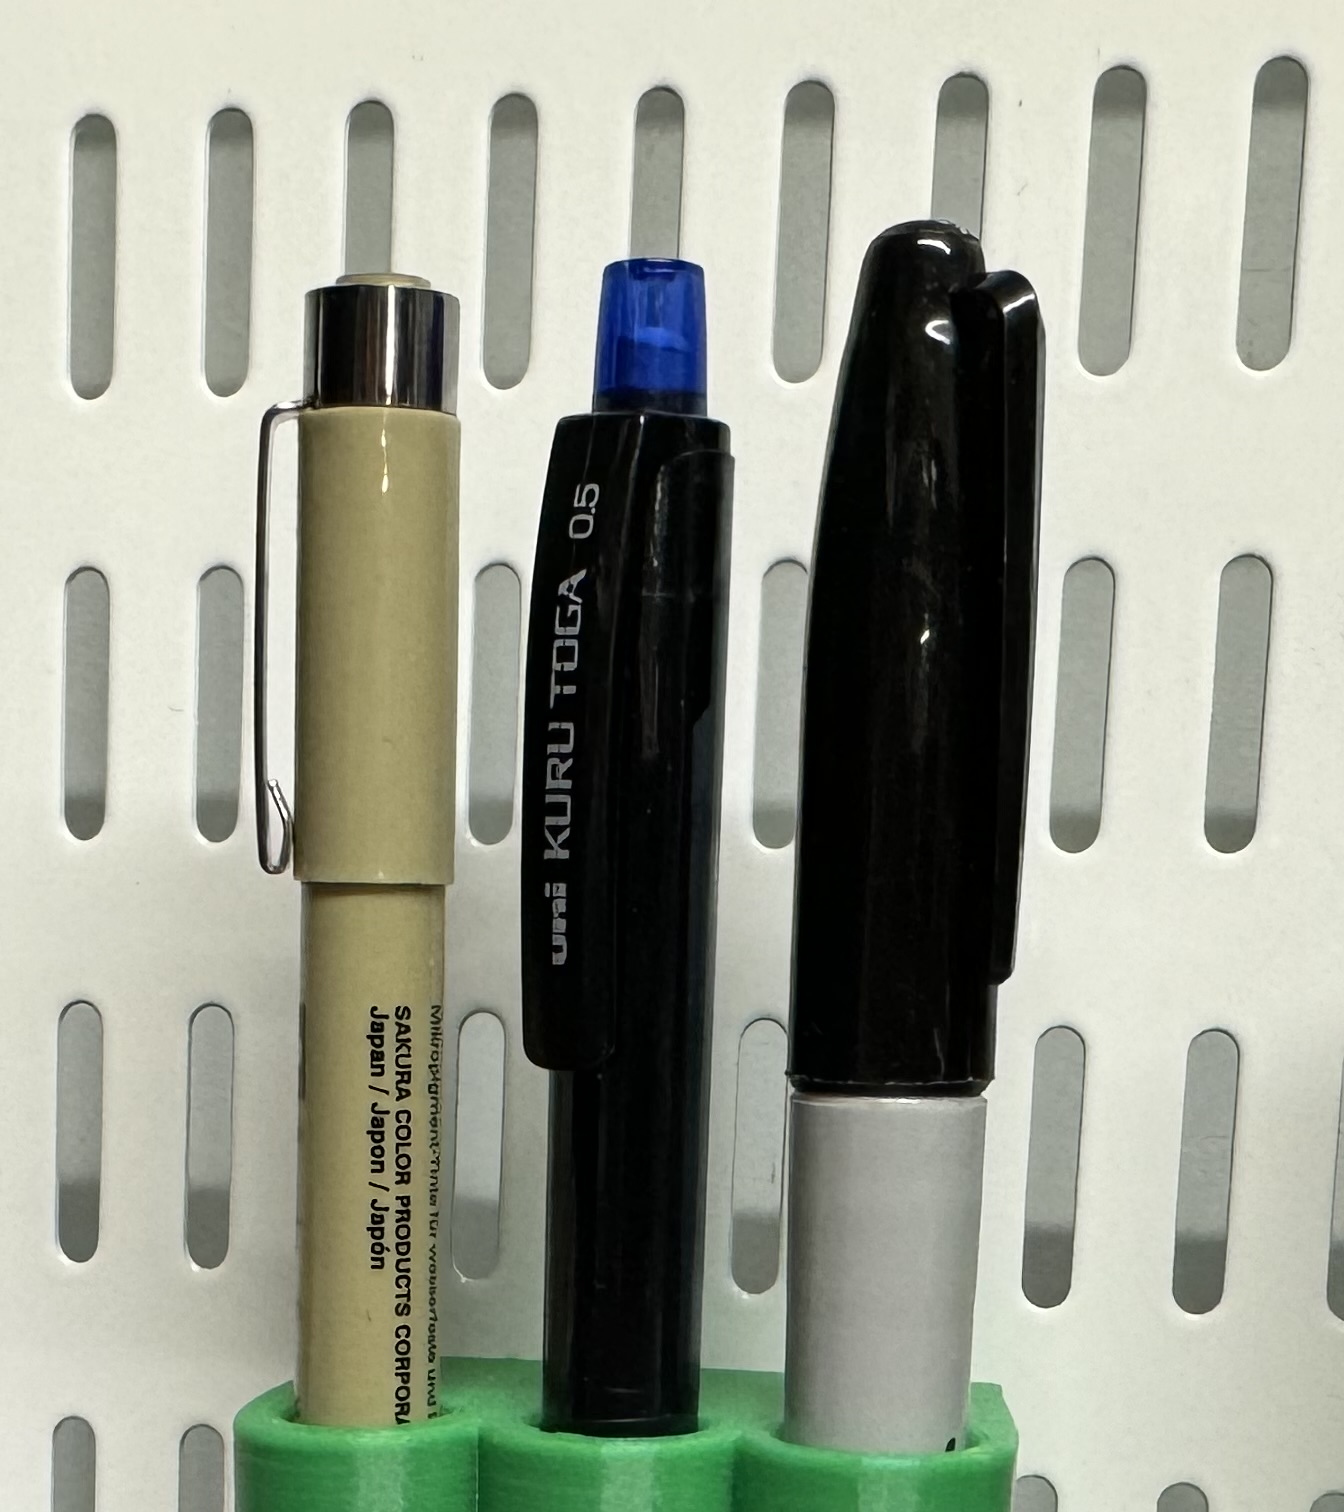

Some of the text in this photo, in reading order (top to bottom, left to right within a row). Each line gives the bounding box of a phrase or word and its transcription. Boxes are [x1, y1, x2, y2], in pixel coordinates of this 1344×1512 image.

[543, 483, 600, 965] uni KURU TOGA 0.5
[366, 1005, 391, 1078] Japan
[394, 1005, 412, 1103] SAKURA
[366, 1101, 391, 1174] Japon
[394, 1109, 413, 1186] COLOR
[366, 1198, 391, 1270] Japón
[394, 1195, 412, 1318] PRODUCTS
